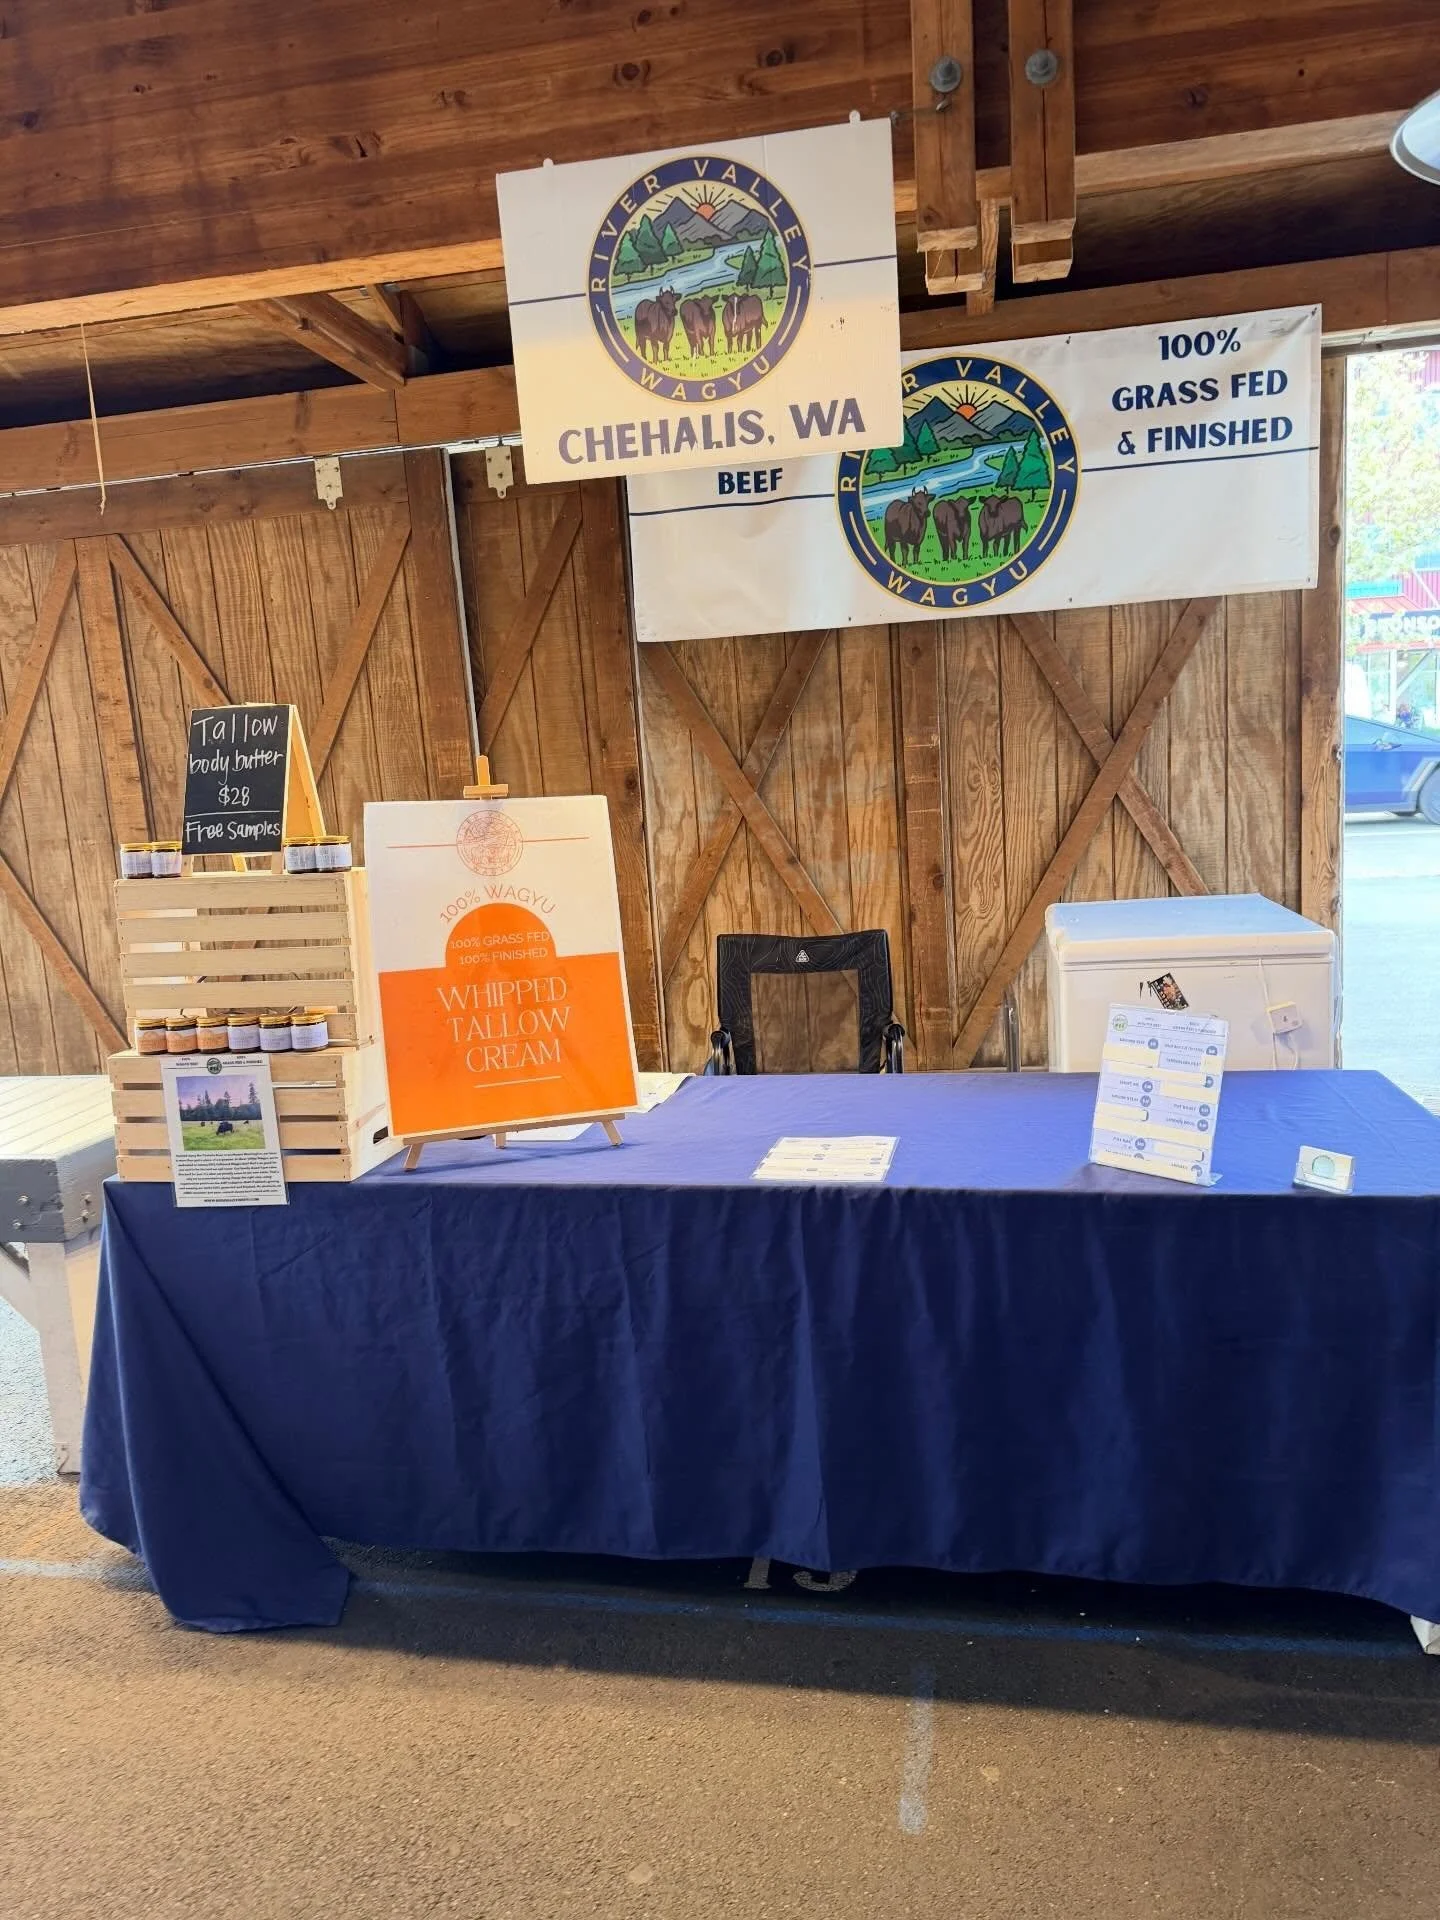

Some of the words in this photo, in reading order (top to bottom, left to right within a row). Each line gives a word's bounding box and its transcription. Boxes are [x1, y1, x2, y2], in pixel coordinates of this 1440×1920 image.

[591, 174, 661, 292] RIVER
[693, 159, 810, 270] VALLEY
[1158, 327, 1241, 360] 100%
[640, 357, 770, 400] WAGYU
[1112, 377, 1219, 411] GRASS
[1231, 369, 1288, 398] FED
[558, 409, 775, 464] CHEHALIS,
[789, 398, 866, 439] WA
[956, 359, 1075, 473] VALLEY
[1117, 431, 1136, 455] &
[1148, 416, 1292, 453] FINISHED
[718, 467, 783, 495] BEEF
[887, 560, 1028, 605] WAGYU
[193, 713, 278, 746] Tallow
[189, 749, 229, 785] body
[232, 748, 284, 772] butter
[218, 784, 250, 806] $28
[185, 821, 224, 843] Free
[227, 820, 280, 840] Samples
[440, 888, 481, 924] 100%
[484, 883, 556, 915] WAGYU
[451, 936, 481, 949] 100%
[483, 933, 524, 946] GRASS
[527, 931, 551, 943] FED
[460, 952, 490, 965] 100%
[492, 947, 548, 961] FINISHED
[436, 976, 567, 1012] WHIPPED
[447, 1006, 571, 1043] TALLOW
[466, 1038, 561, 1072] CREAM
